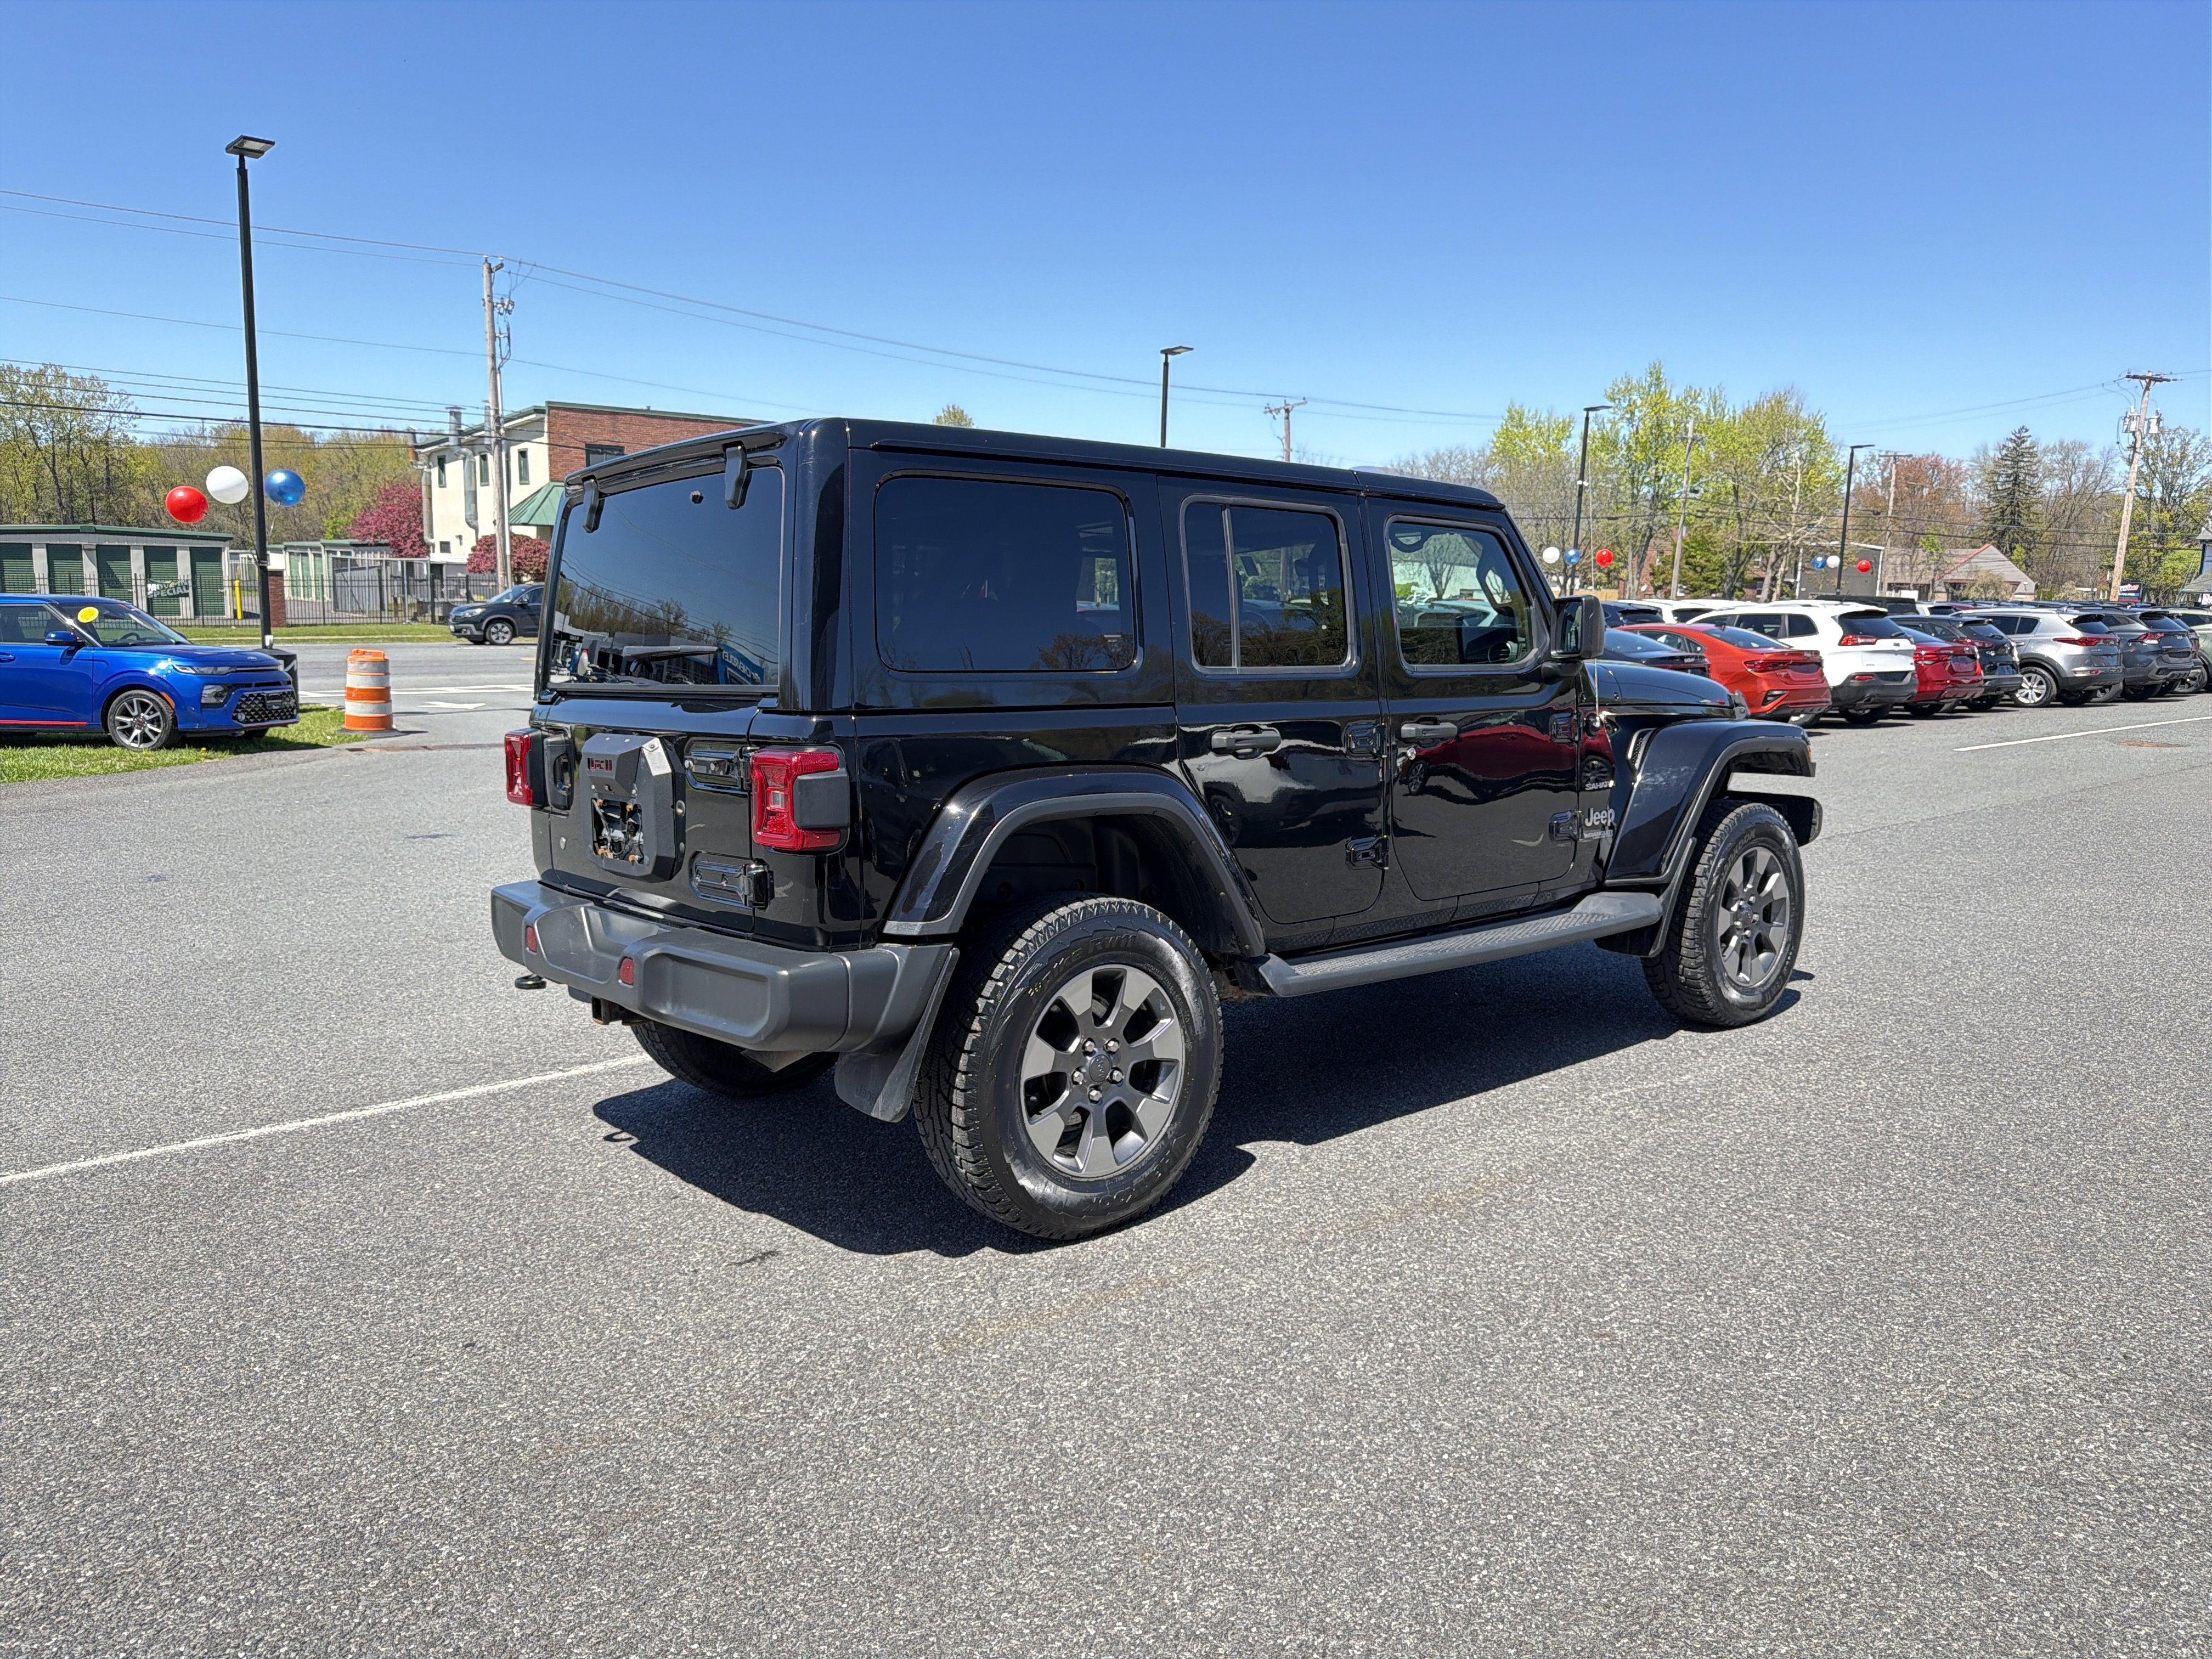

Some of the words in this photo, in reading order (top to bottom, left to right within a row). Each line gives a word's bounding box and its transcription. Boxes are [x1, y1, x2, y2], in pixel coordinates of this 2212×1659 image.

[147, 585, 189, 599] SPECIAL
[1585, 780, 1615, 791] SAHA
[1584, 808, 1615, 827] Jeep
